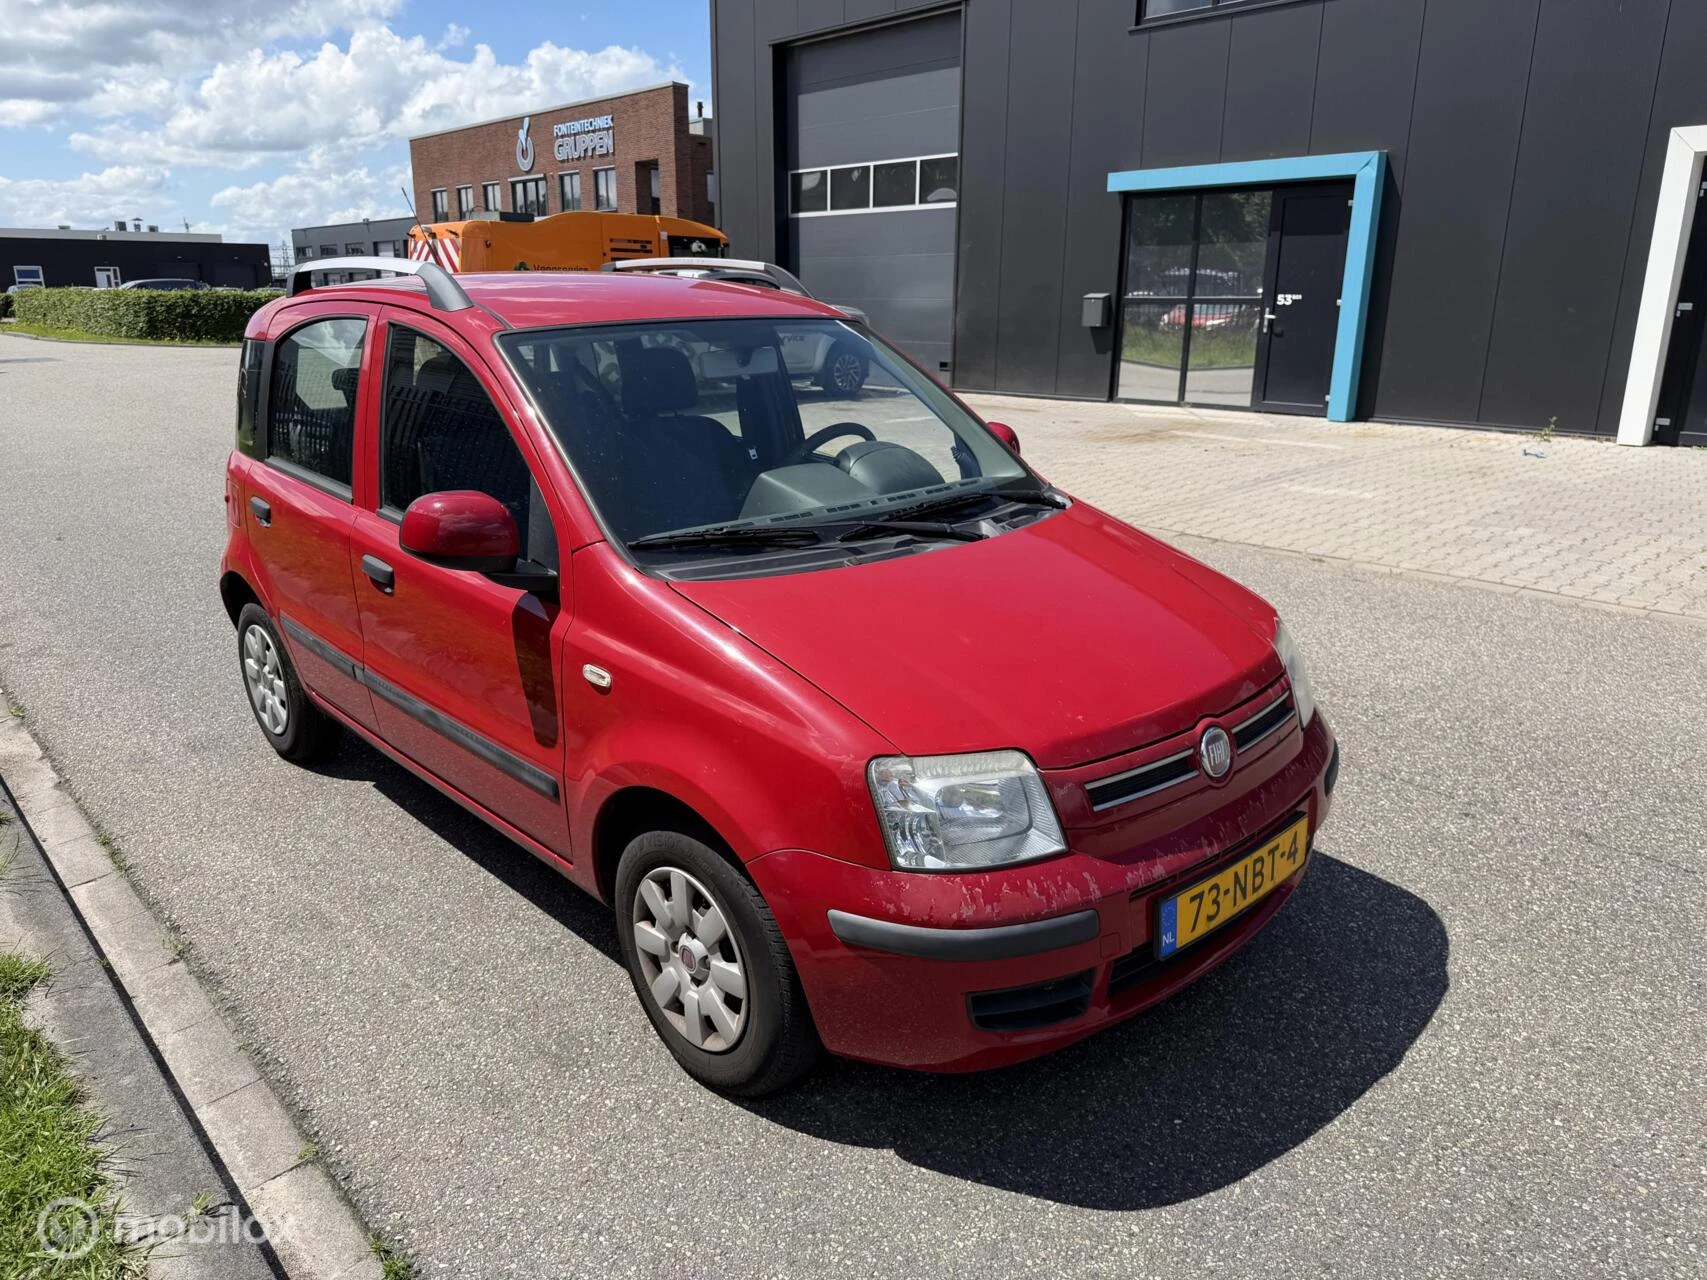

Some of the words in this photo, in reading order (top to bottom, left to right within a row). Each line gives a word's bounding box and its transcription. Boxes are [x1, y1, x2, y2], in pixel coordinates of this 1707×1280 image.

[554, 130, 614, 160] GRUPPEN
[1208, 740, 1228, 766] FIAT
[1189, 831, 1299, 933] 73-NBT-4
[1162, 931, 1174, 946] NL
